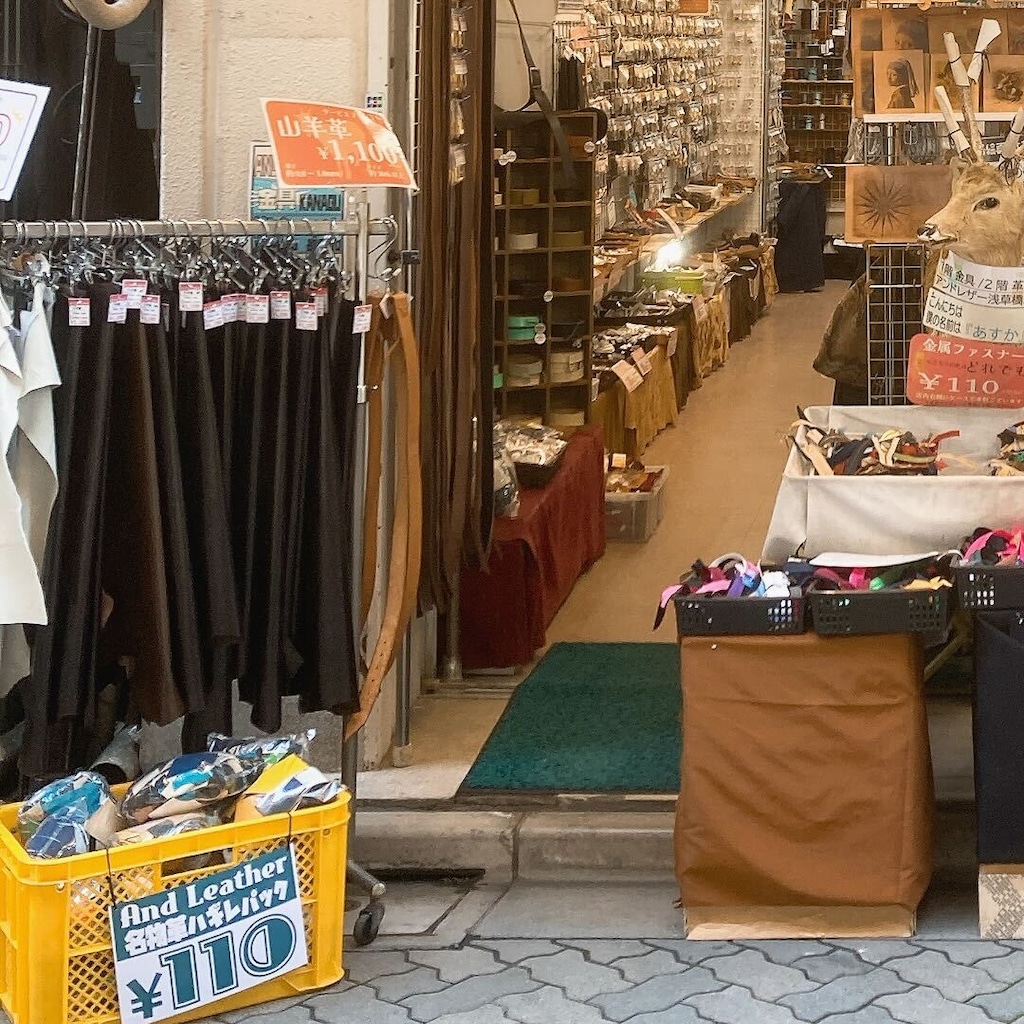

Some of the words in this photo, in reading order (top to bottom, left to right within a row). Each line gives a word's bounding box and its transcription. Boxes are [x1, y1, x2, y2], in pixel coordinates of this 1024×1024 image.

[276, 114, 353, 140] 山羊革
[317, 138, 403, 166] ¥1,100
[928, 293, 963, 318] こんにちは
[923, 337, 1024, 360] 金属ファスナー
[918, 371, 1000, 395] ¥110
[120, 891, 179, 928] And
[186, 855, 288, 909] Leather
[124, 879, 290, 956] 各種革ハギレパック
[126, 913, 297, 1019] ¥110
